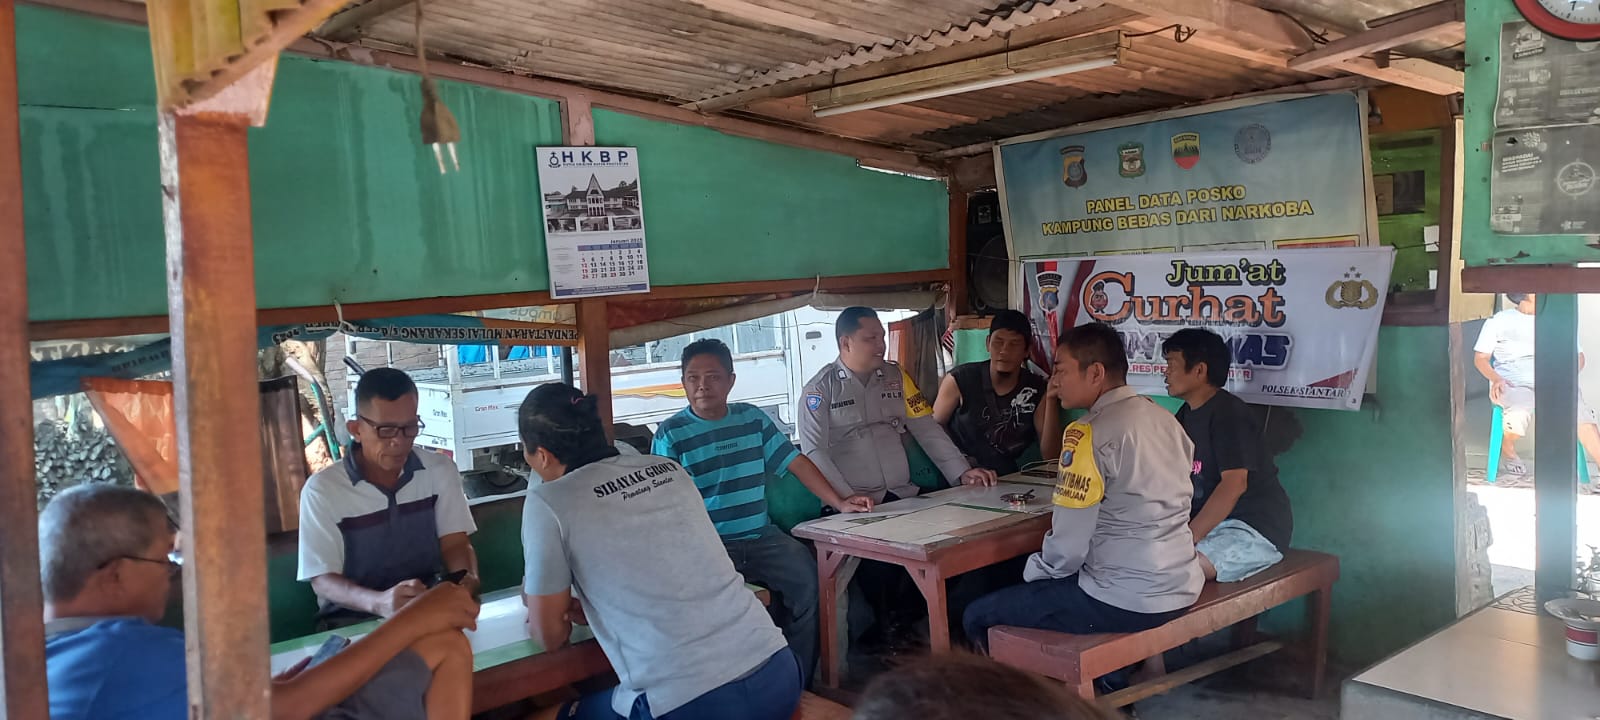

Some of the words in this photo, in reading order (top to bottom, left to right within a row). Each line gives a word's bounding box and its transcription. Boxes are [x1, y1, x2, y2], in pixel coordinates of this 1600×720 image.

[1570, 1, 1577, 11] 7
[1087, 199, 1135, 214] PANEL
[1139, 192, 1182, 208] DATA
[1186, 185, 1246, 204] POSKO
[1042, 217, 1114, 236] KAMPUNG
[1117, 211, 1171, 230] BEBAS
[1175, 205, 1217, 225] DARI
[1222, 199, 1314, 219] NARKOBA
[1083, 271, 1286, 327] Curhat
[401, 327, 466, 339] SEKARANG
[466, 327, 503, 340] MULAI
[505, 329, 578, 341] PENDAFTARAN
[1261, 384, 1299, 394] POLSEK
[1299, 386, 1345, 398] SIANTAR
[593, 470, 647, 498] SIBAYAK
[645, 461, 679, 478] GROUP
